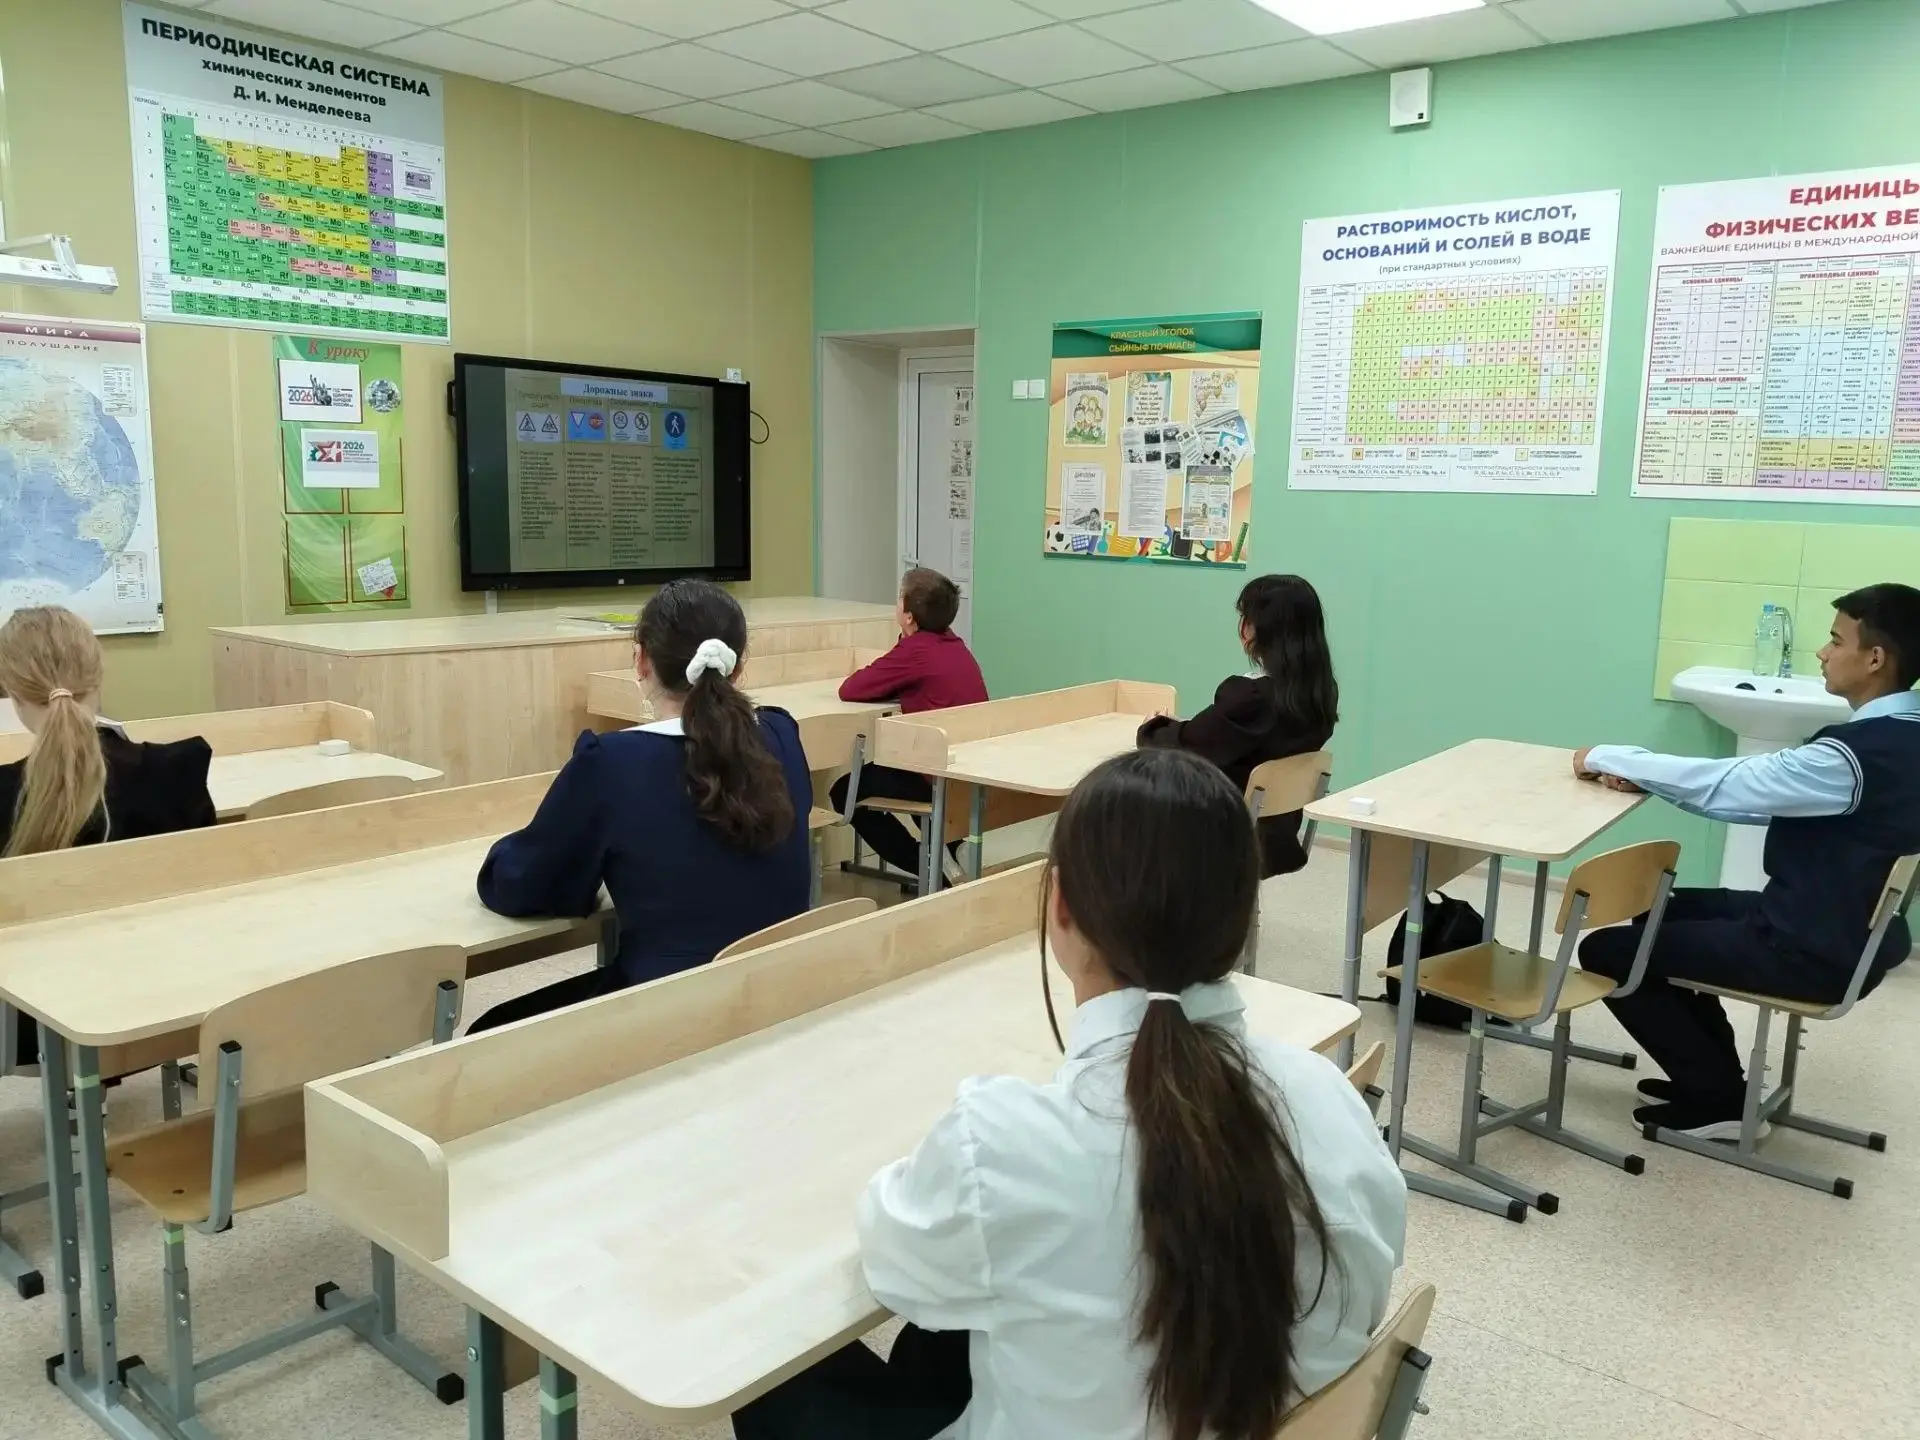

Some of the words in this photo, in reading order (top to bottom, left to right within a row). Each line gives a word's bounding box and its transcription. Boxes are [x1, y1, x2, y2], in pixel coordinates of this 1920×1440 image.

[141, 18, 334, 75] ПЕРИОДИЧЕСКАЯ
[340, 64, 431, 97] СИСТЕМА
[202, 58, 303, 90] химических
[307, 82, 386, 106] элементов
[233, 85, 251, 100] Д.
[255, 89, 271, 104] И.
[276, 93, 371, 123] Менделеева
[196, 152, 209, 162] Mg
[184, 182, 196, 190] Cu
[228, 188, 240, 196] Ga
[1337, 213, 1490, 238] РАСТВОРИМОСТЬ
[1495, 205, 1577, 224] КИСЛОТ,
[1705, 211, 1878, 238] ФИЗИЧЕСКИХ
[1885, 208, 1920, 226] ВЕ
[187, 246, 198, 254] Au
[1322, 237, 1430, 261] ОСНОВАНИЙ
[1435, 239, 1447, 253] И
[1453, 230, 1515, 251] СОЛЕЙ
[1520, 233, 1532, 246] В
[1538, 227, 1591, 245] ВОДЕ
[1661, 244, 1731, 256] ВАЖНЕЙШИЕ
[1734, 240, 1791, 252] ЕДИНИЦЫ
[1804, 231, 1919, 248] МЕЖДУНАРОДНОЙ
[1379, 265, 1401, 275] (при
[1403, 260, 1467, 273] стандартных
[1469, 256, 1521, 268] условиях)
[25, 326, 89, 338] МИРА
[1110, 327, 1159, 340] КЛАССНЫЙ
[1160, 327, 1195, 337] УГОЛОК
[7, 340, 99, 352] ПОЛУШАРИЕ
[324, 344, 370, 362] уроку
[288, 389, 313, 402] 2026
[583, 383, 627, 398] Дорожные
[630, 389, 654, 398] знаки
[343, 441, 364, 450] 2026
